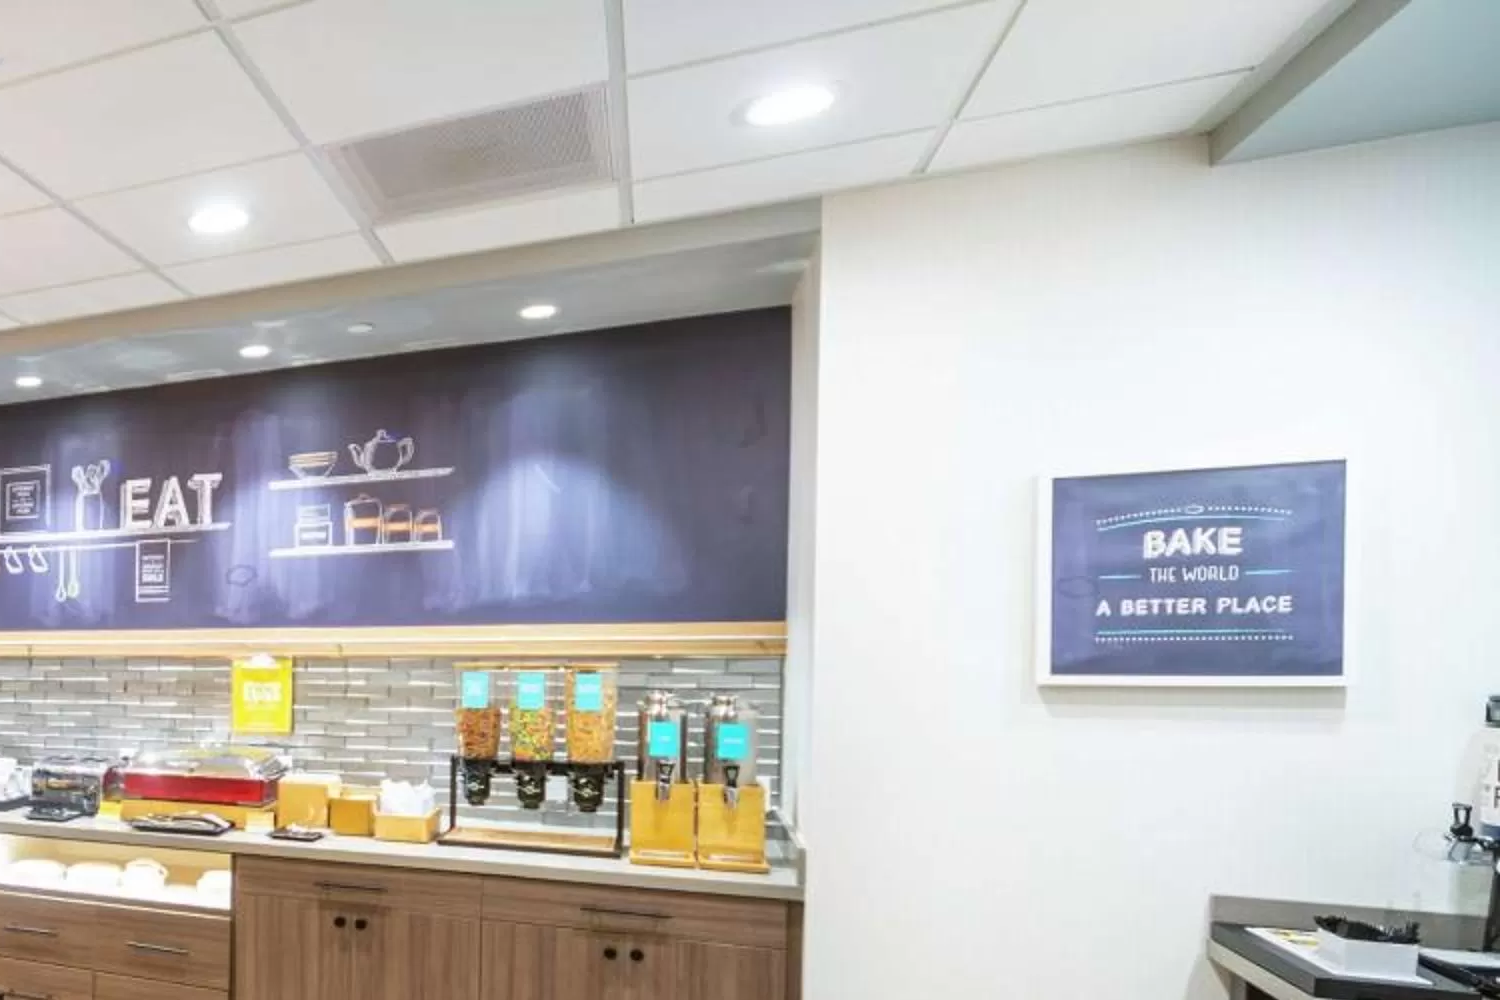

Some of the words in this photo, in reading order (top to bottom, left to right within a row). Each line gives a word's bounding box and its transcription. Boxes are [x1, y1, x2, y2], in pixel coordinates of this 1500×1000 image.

[120, 472, 223, 528] EAT
[1142, 526, 1244, 559] BAKE
[1149, 566, 1176, 583] THE
[1182, 565, 1240, 582] WORLD
[1095, 599, 1112, 616] A
[1120, 597, 1207, 616] BETTER
[1216, 595, 1293, 615] PLACE
